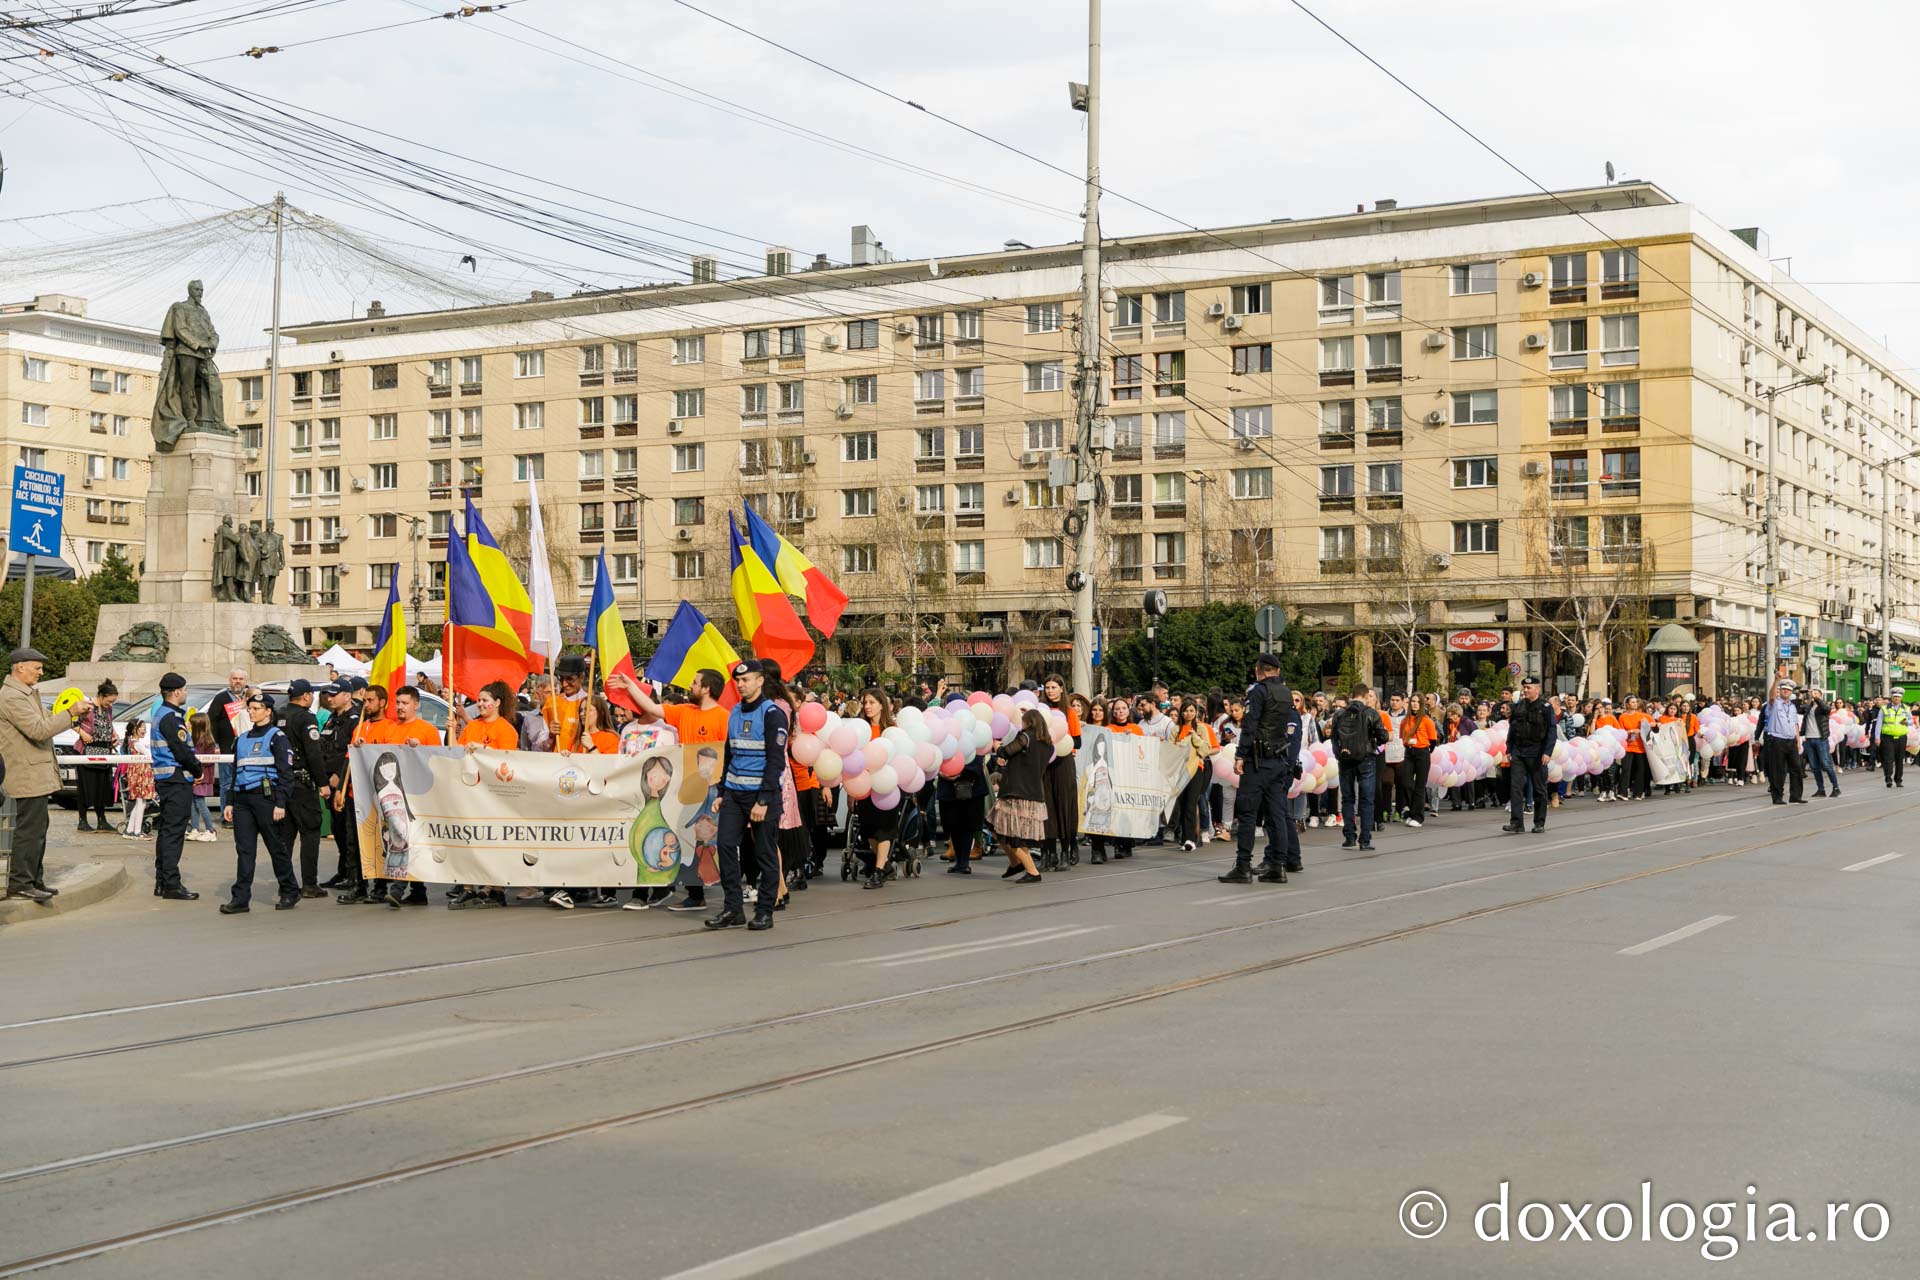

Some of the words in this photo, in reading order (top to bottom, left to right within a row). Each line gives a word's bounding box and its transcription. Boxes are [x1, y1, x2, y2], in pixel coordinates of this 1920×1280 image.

[46, 495, 62, 506] PASAJ
[1780, 619, 1792, 635] P
[502, 826, 574, 842] PENTRU
